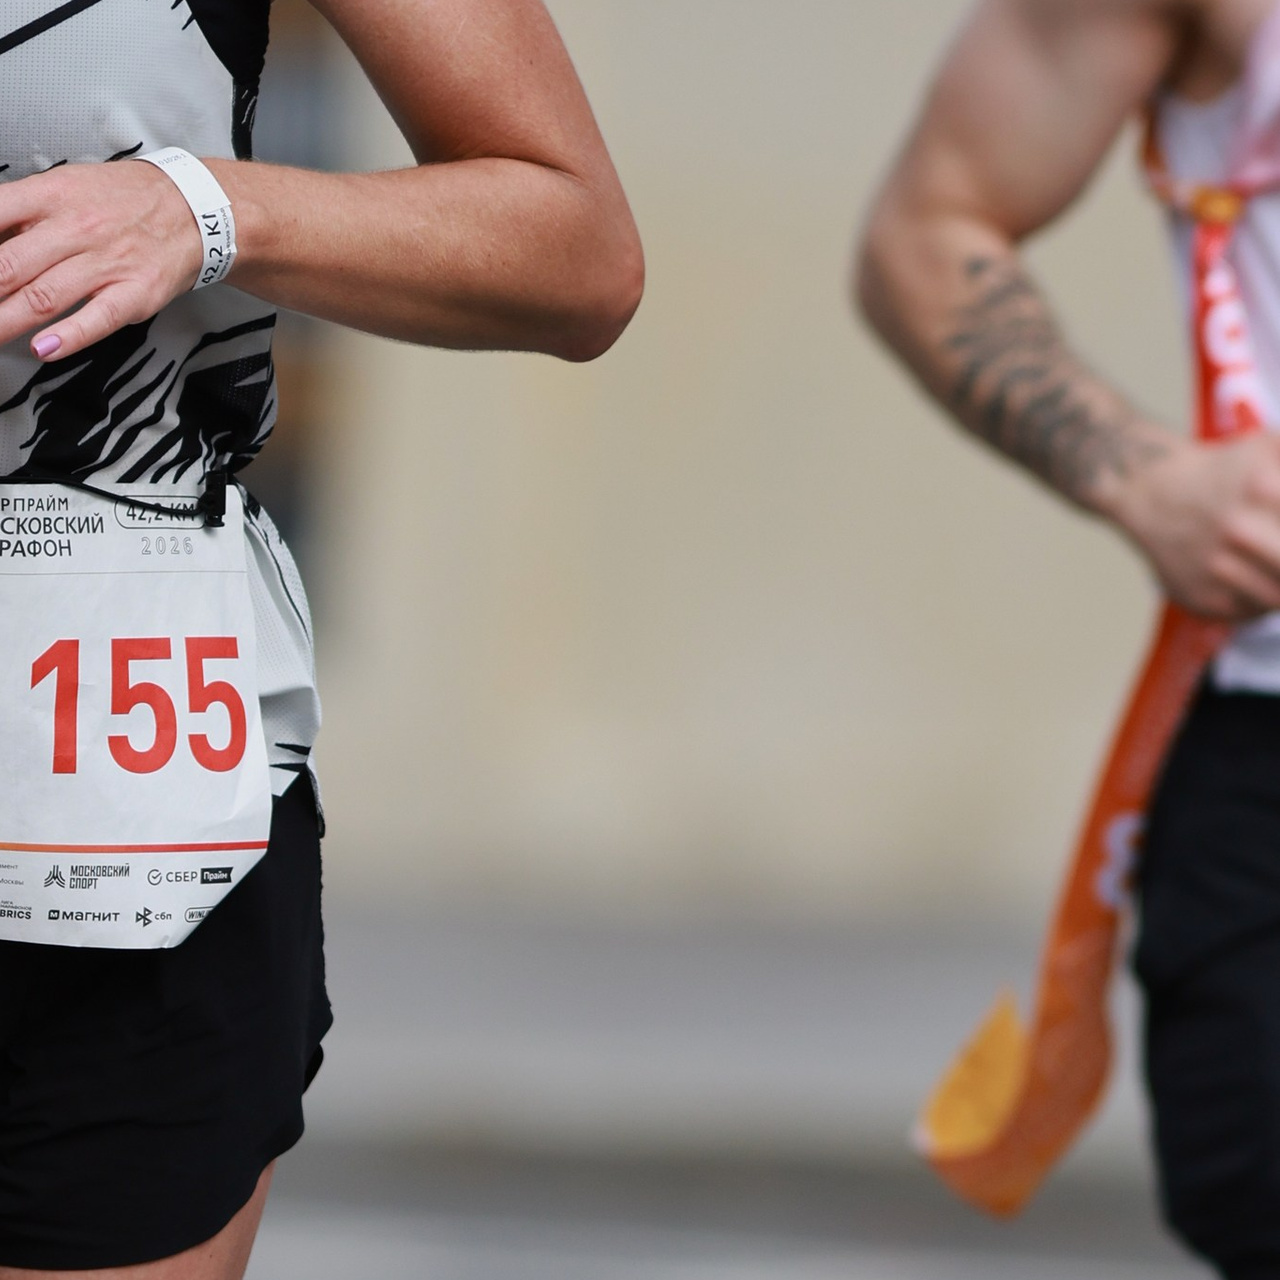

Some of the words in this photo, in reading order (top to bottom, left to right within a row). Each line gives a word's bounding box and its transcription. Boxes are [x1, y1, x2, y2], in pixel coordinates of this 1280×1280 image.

[141, 536, 193, 555] 2026
[70, 863, 130, 877] МОСКОВСКИЙ
[165, 871, 198, 882] СБЕР
[203, 870, 228, 881] Прайм
[69, 877, 99, 889] СПОРТ
[0, 909, 32, 920] BRICS
[154, 912, 172, 920] сбп
